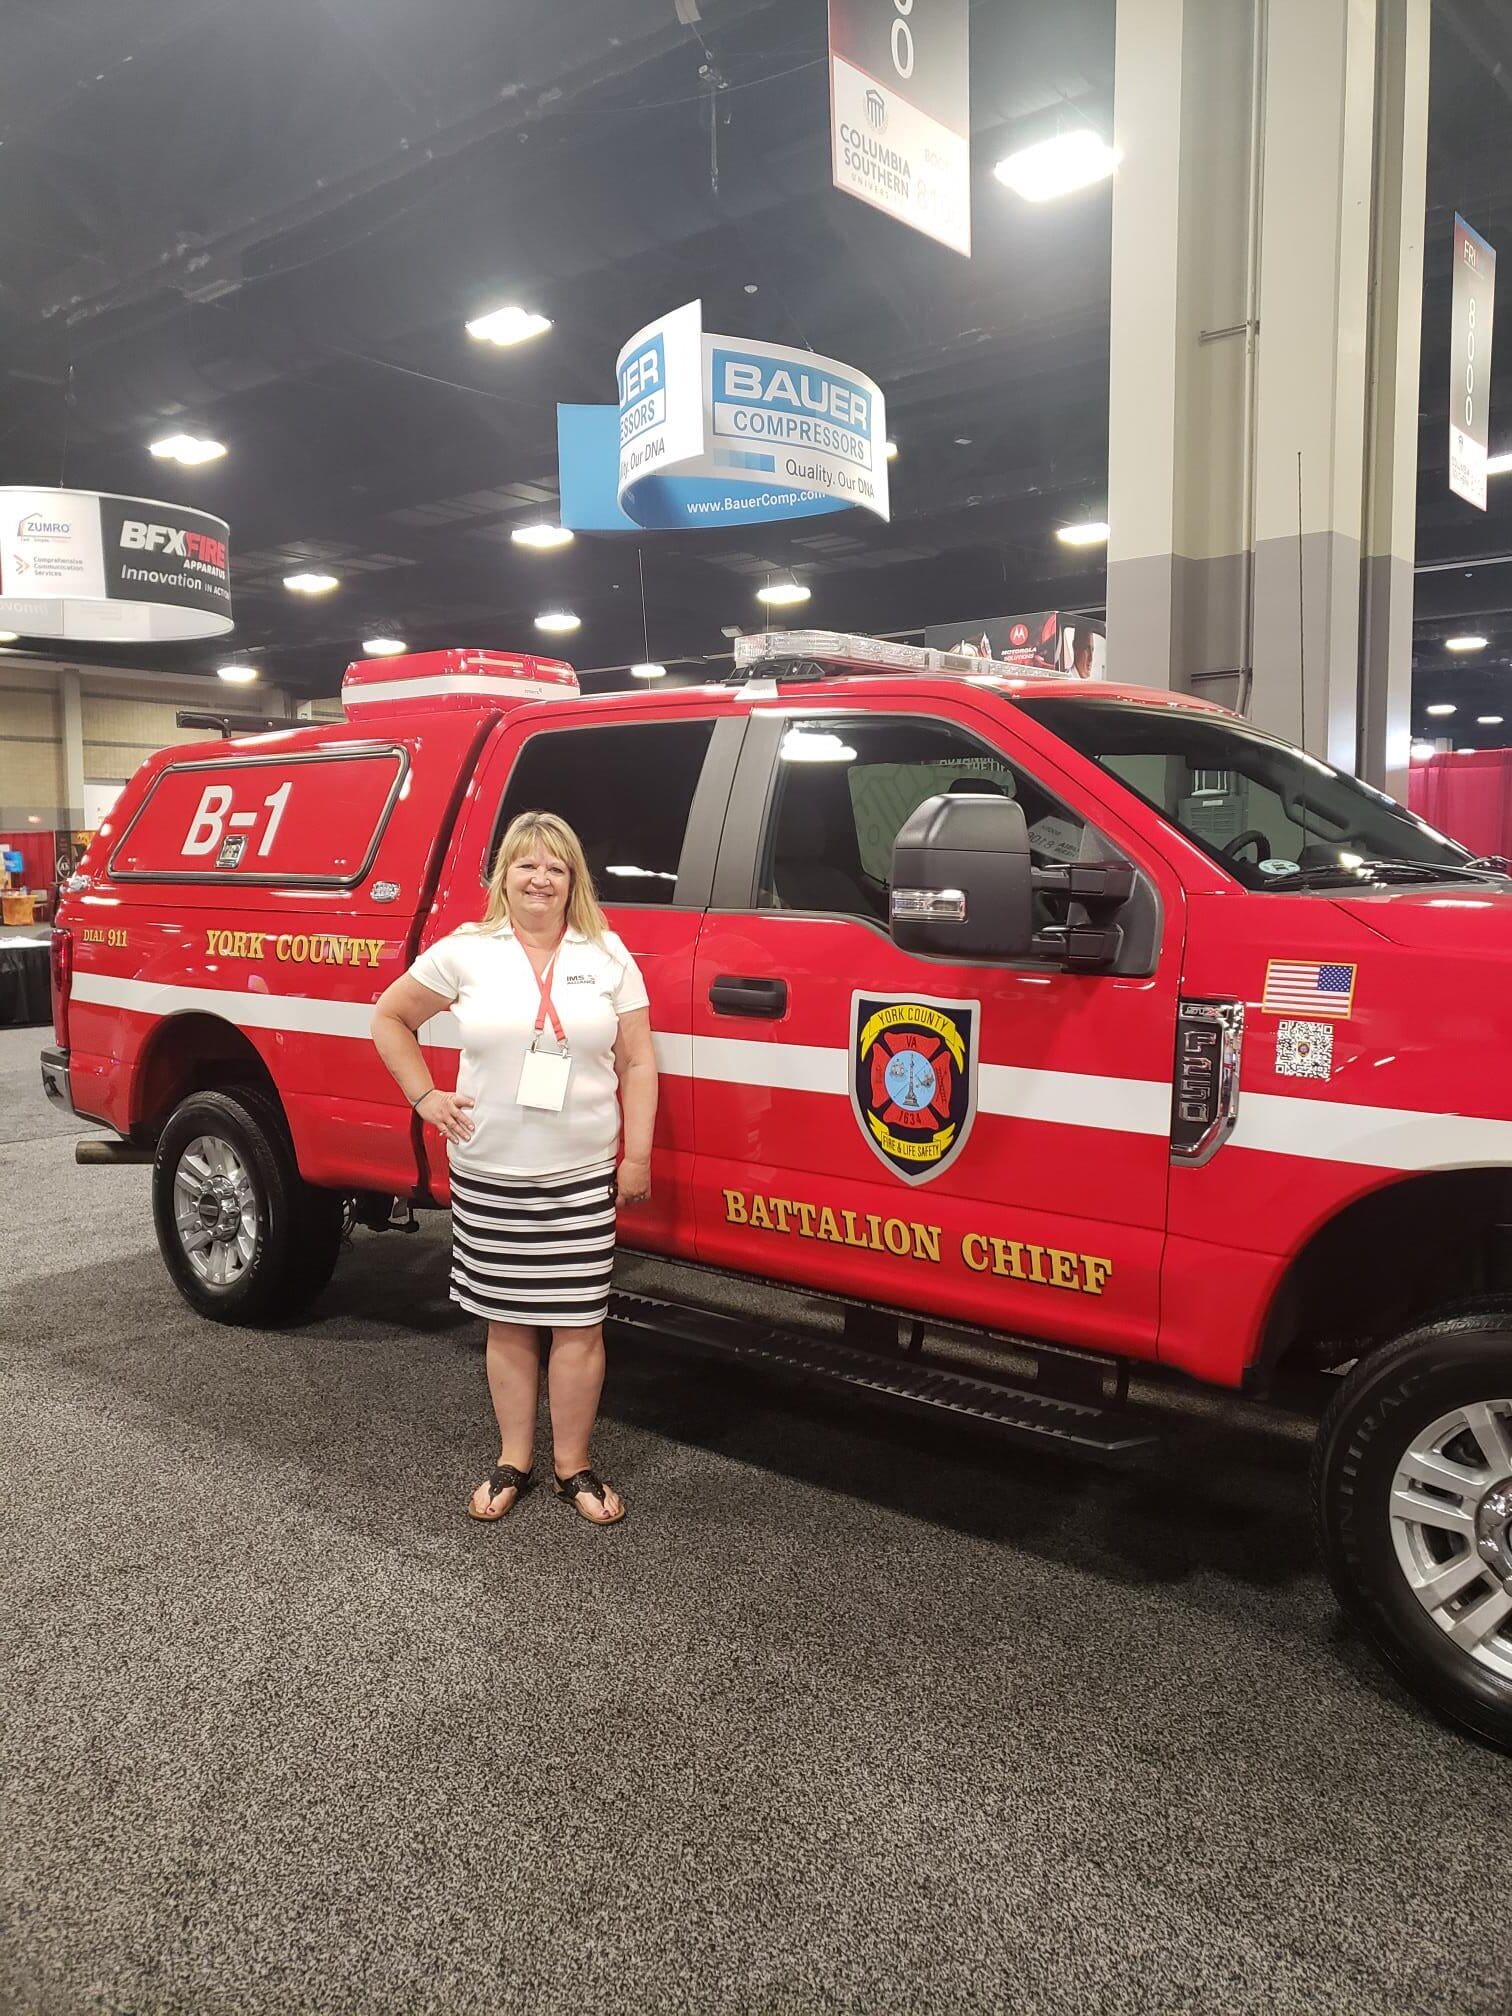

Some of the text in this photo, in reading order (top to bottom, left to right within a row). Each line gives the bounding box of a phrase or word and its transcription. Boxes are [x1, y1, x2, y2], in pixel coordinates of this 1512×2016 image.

[840, 123, 911, 179] COLUMBIA
[844, 147, 910, 200] SOUTHERN
[1464, 297, 1476, 427] 8000
[724, 360, 868, 432] BAUER
[733, 410, 865, 461] COMPRESSORS
[630, 451, 643, 470] Our
[645, 437, 665, 461] DNA
[785, 458, 875, 499] Quality. Our DNA
[27, 522, 70, 533] ZUMRO
[121, 564, 202, 591] Innovation
[183, 559, 226, 580] APPARATUS
[1001, 647, 1037, 656] MOTOROLA
[1003, 653, 1035, 662] SOLUTIONS
[180, 781, 293, 856] B-1
[83, 928, 128, 947] DIAL 911
[205, 930, 385, 968] YORK COUNTY
[877, 1007, 948, 1032] YORK COUNTY
[906, 1034, 917, 1048] VA
[898, 1111, 922, 1126] 1634
[883, 1136, 940, 1157] FIRE & LIFE SAFETY
[722, 1189, 1113, 1296] BATTALION CHIEF
